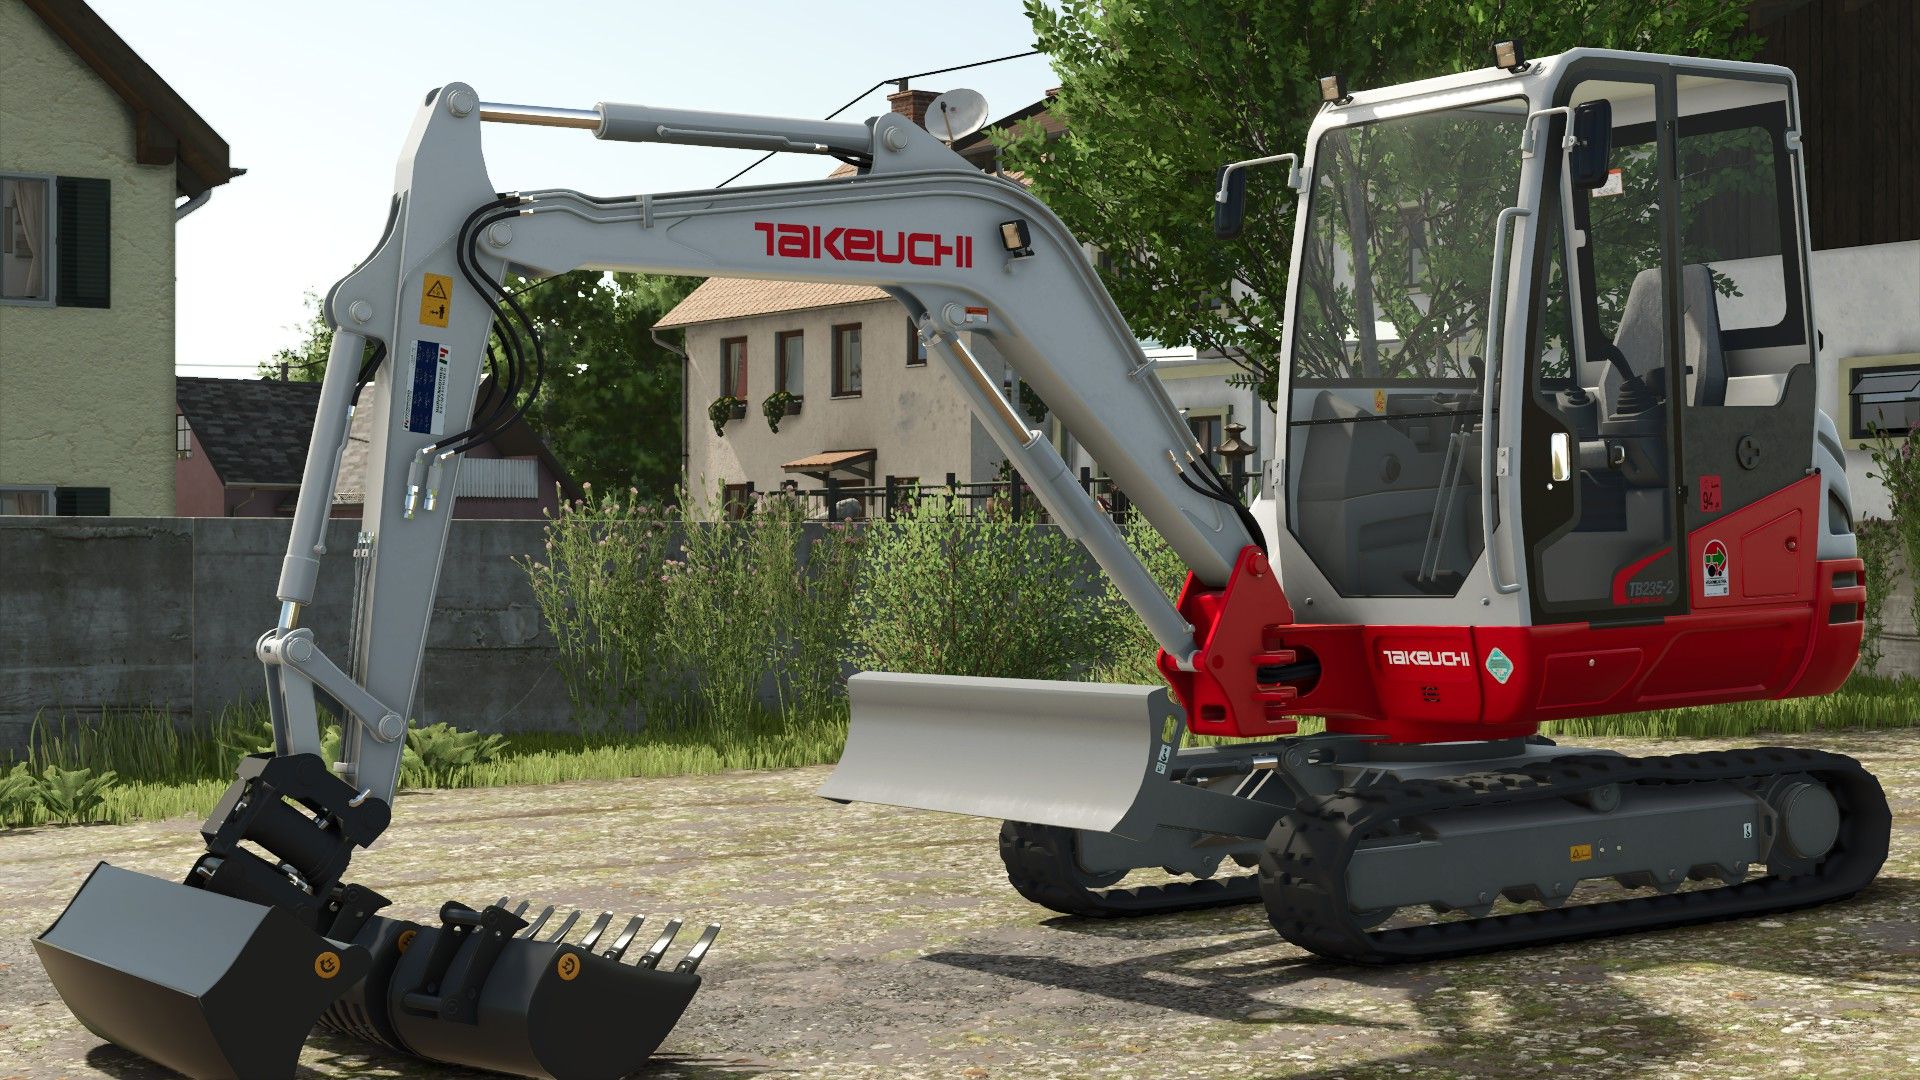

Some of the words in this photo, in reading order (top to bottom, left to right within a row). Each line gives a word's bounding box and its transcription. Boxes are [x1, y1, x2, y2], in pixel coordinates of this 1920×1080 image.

[754, 222, 973, 269] TAKEUCHI
[1629, 579, 1674, 597] TB235-2
[1383, 650, 1470, 667] TAKEUCHI
